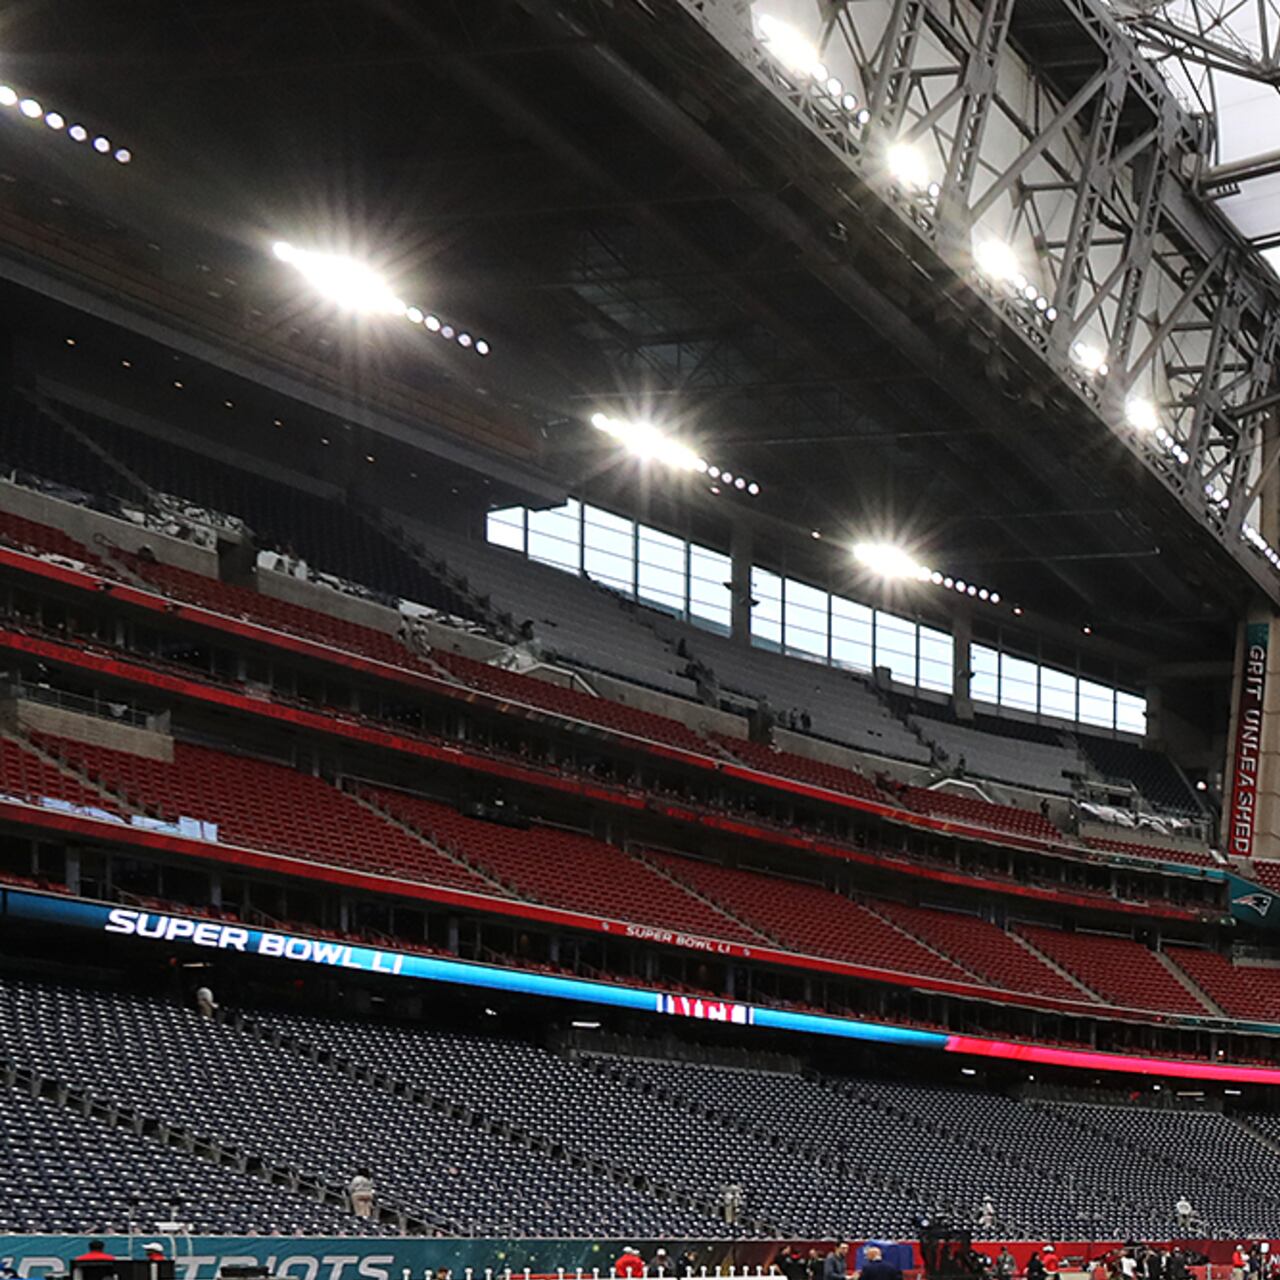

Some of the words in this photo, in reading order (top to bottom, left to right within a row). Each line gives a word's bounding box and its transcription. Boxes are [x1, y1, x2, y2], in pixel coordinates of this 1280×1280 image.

[1246, 644, 1266, 702] GRIT
[1234, 709, 1261, 854] UNLEASHED
[104, 908, 250, 951] SUPER
[258, 933, 362, 969] BOWL
[372, 953, 404, 975] LI
[626, 926, 673, 943] SUPER
[676, 935, 714, 952] BOWL
[718, 944, 730, 953] LI
